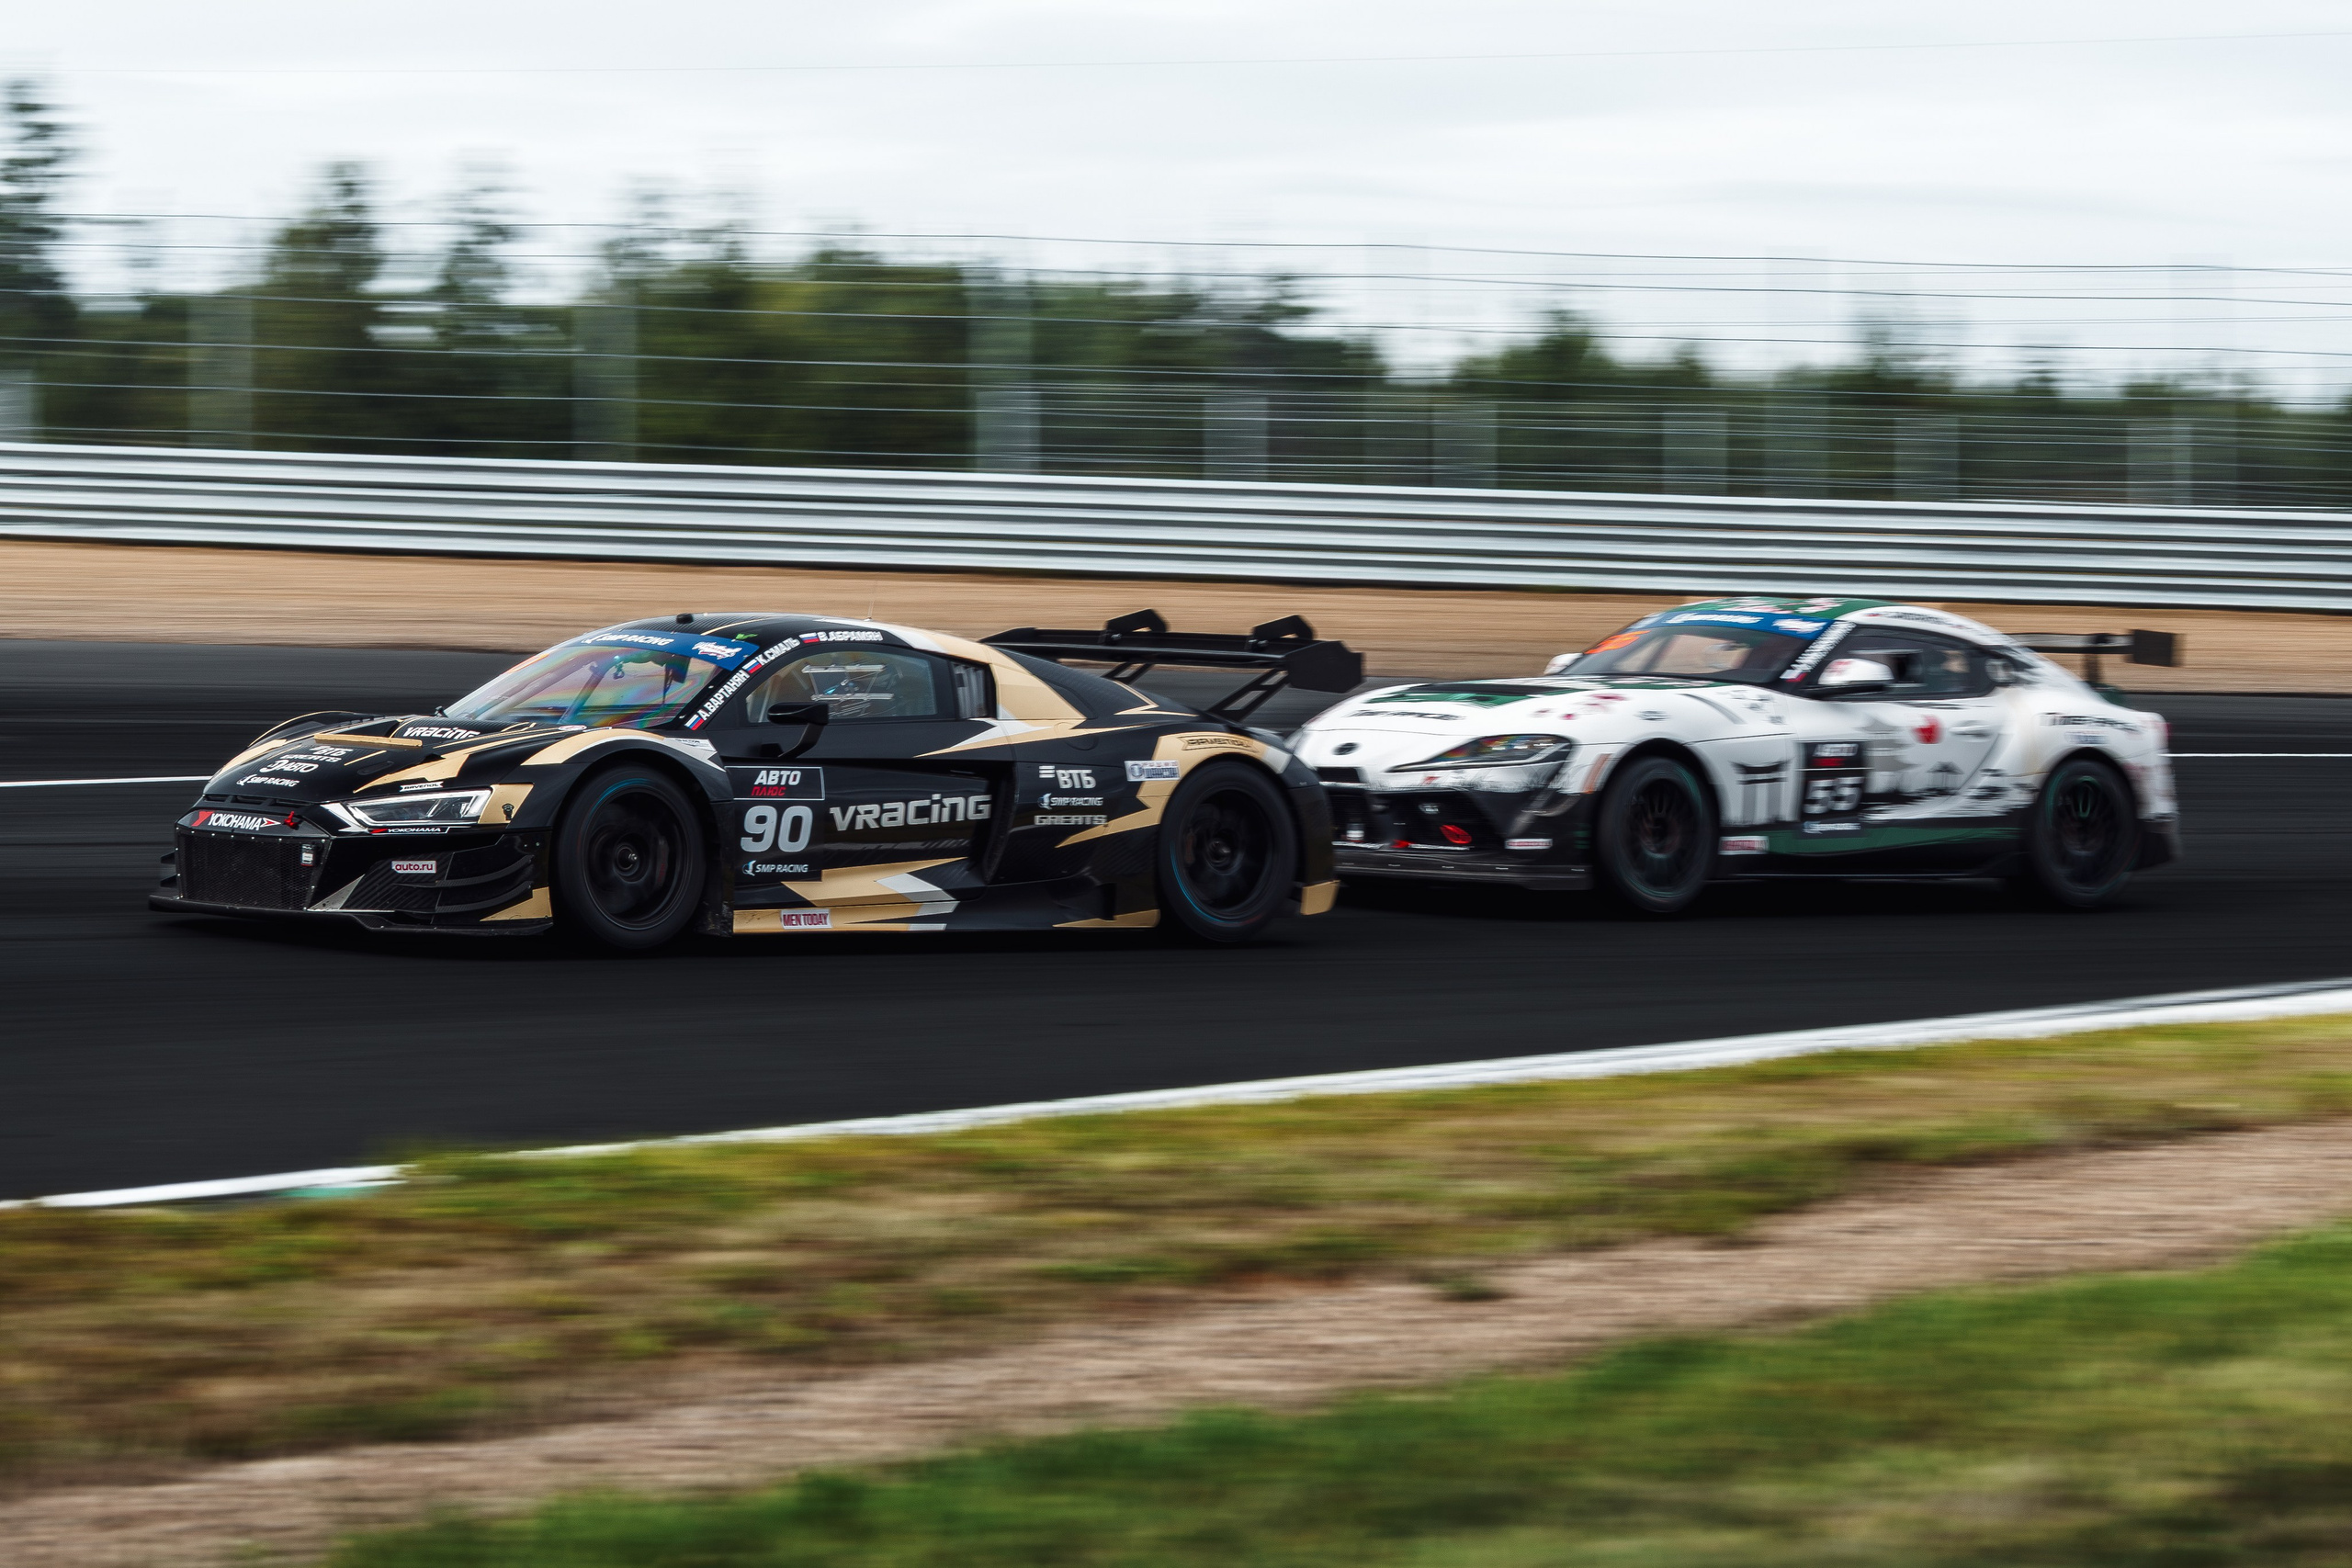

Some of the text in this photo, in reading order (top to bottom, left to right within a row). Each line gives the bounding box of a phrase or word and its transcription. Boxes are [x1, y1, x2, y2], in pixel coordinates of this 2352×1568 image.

[754, 637, 800, 666] К.СМАЛЬ
[696, 669, 751, 721] А.ВАРТАНЯН
[265, 778, 300, 787] RACING
[754, 771, 801, 785] АВТО
[1056, 770, 1096, 788] ВТБ
[751, 786, 786, 796] ПЛЮС
[208, 813, 263, 830] YOKOHAMA
[740, 806, 813, 852] 90
[755, 864, 808, 873] SMP RACING
[783, 913, 829, 926] MEN TODAY
